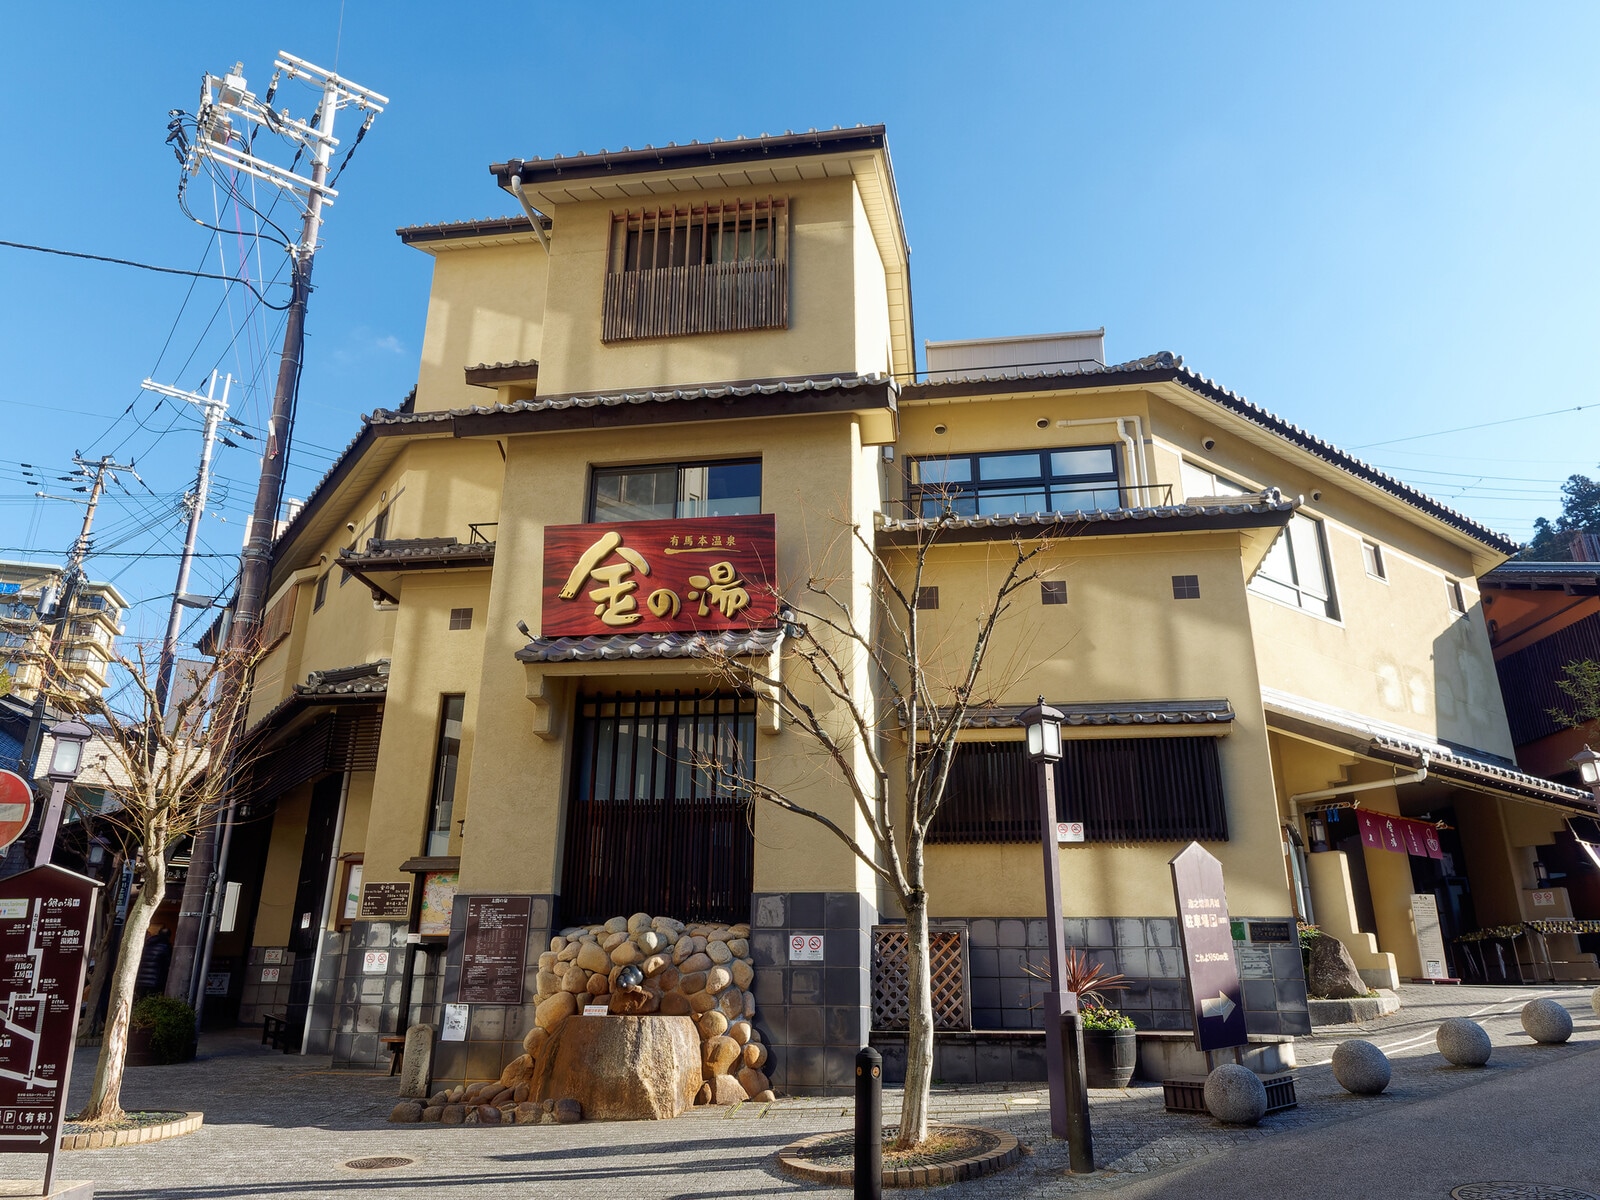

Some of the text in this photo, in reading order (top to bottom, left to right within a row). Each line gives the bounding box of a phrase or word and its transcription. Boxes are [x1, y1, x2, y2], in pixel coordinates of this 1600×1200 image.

[670, 534, 737, 547] 有馬本温泉
[559, 531, 750, 626] 金の湯
[47, 897, 73, 908] 銀の湯
[18, 1112, 54, 1123] (有料)
